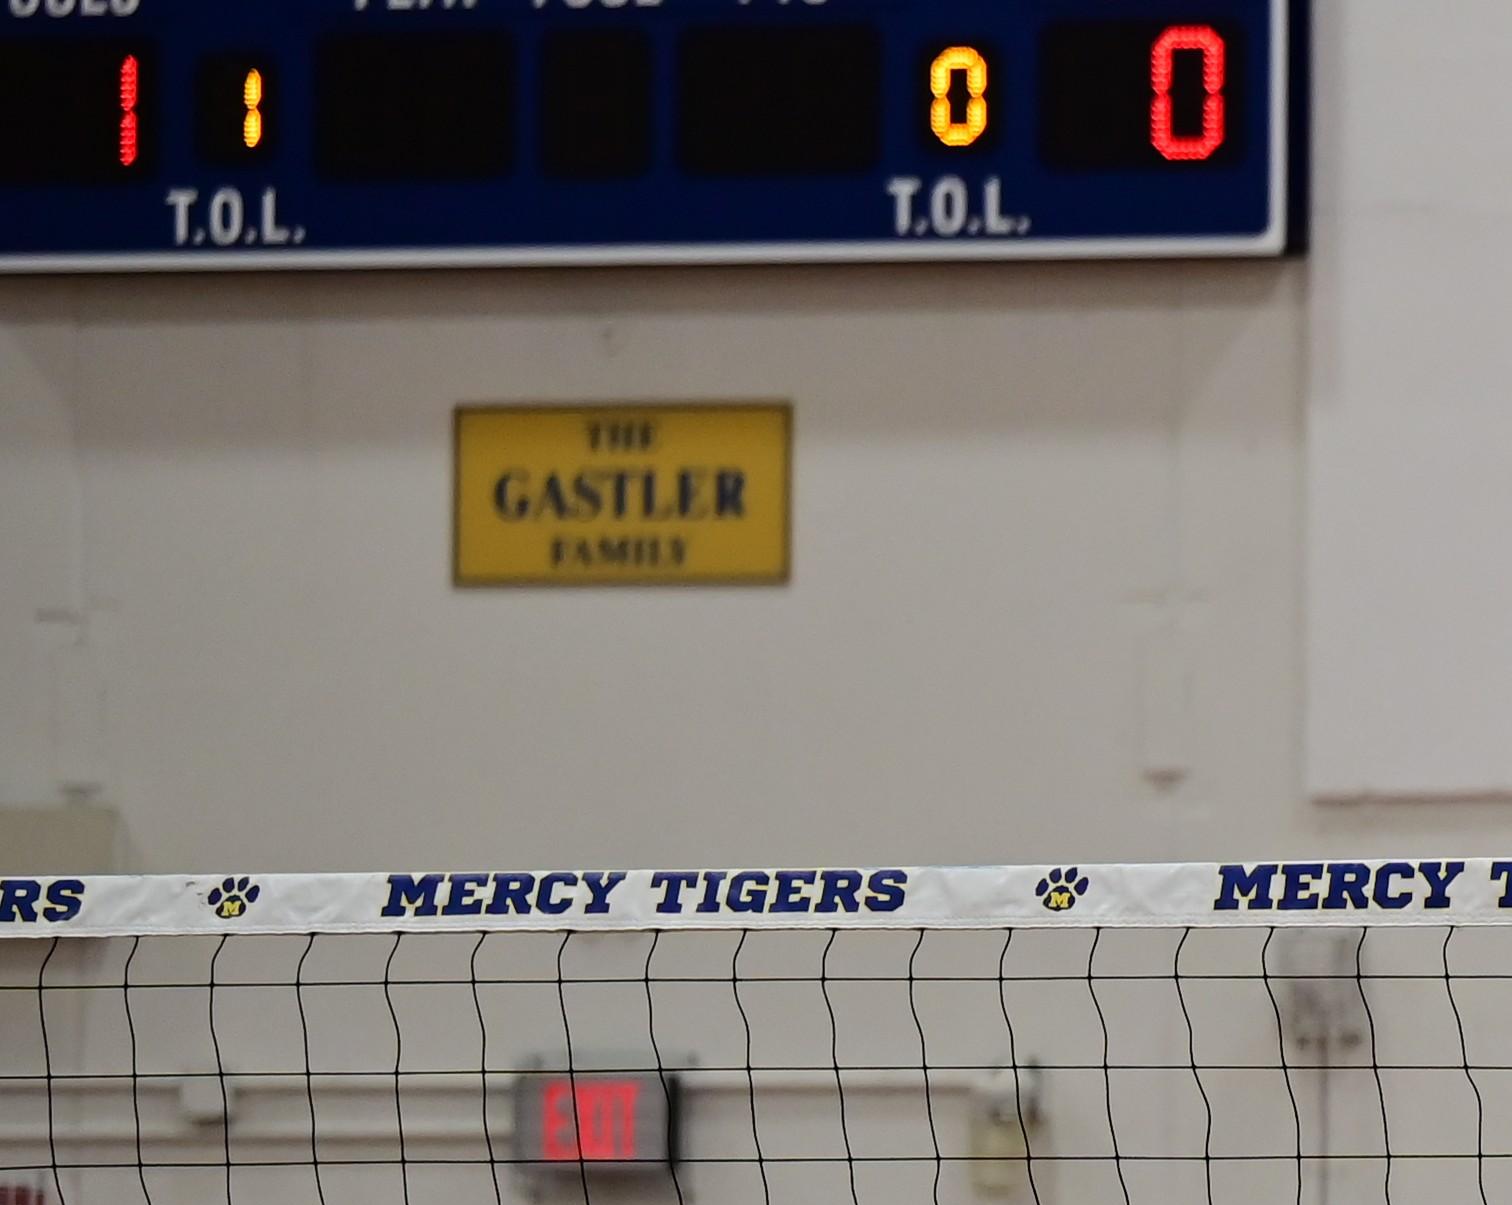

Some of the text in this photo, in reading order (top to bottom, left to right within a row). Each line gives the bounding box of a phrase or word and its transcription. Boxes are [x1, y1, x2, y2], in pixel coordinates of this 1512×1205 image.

[119, 54, 139, 166] 1
[243, 67, 263, 148] 1
[930, 46, 987, 146] 0
[1150, 25, 1226, 161] 0
[165, 187, 307, 245] T.O.L.
[887, 174, 1031, 236] T.O.L.
[587, 421, 655, 450] THE
[493, 467, 746, 521] GASTLER
[551, 537, 688, 567] FAMILY
[381, 869, 907, 918] MERCY TIGERS
[1214, 861, 1464, 911] MERCY
[543, 1079, 641, 1160] EXIT
